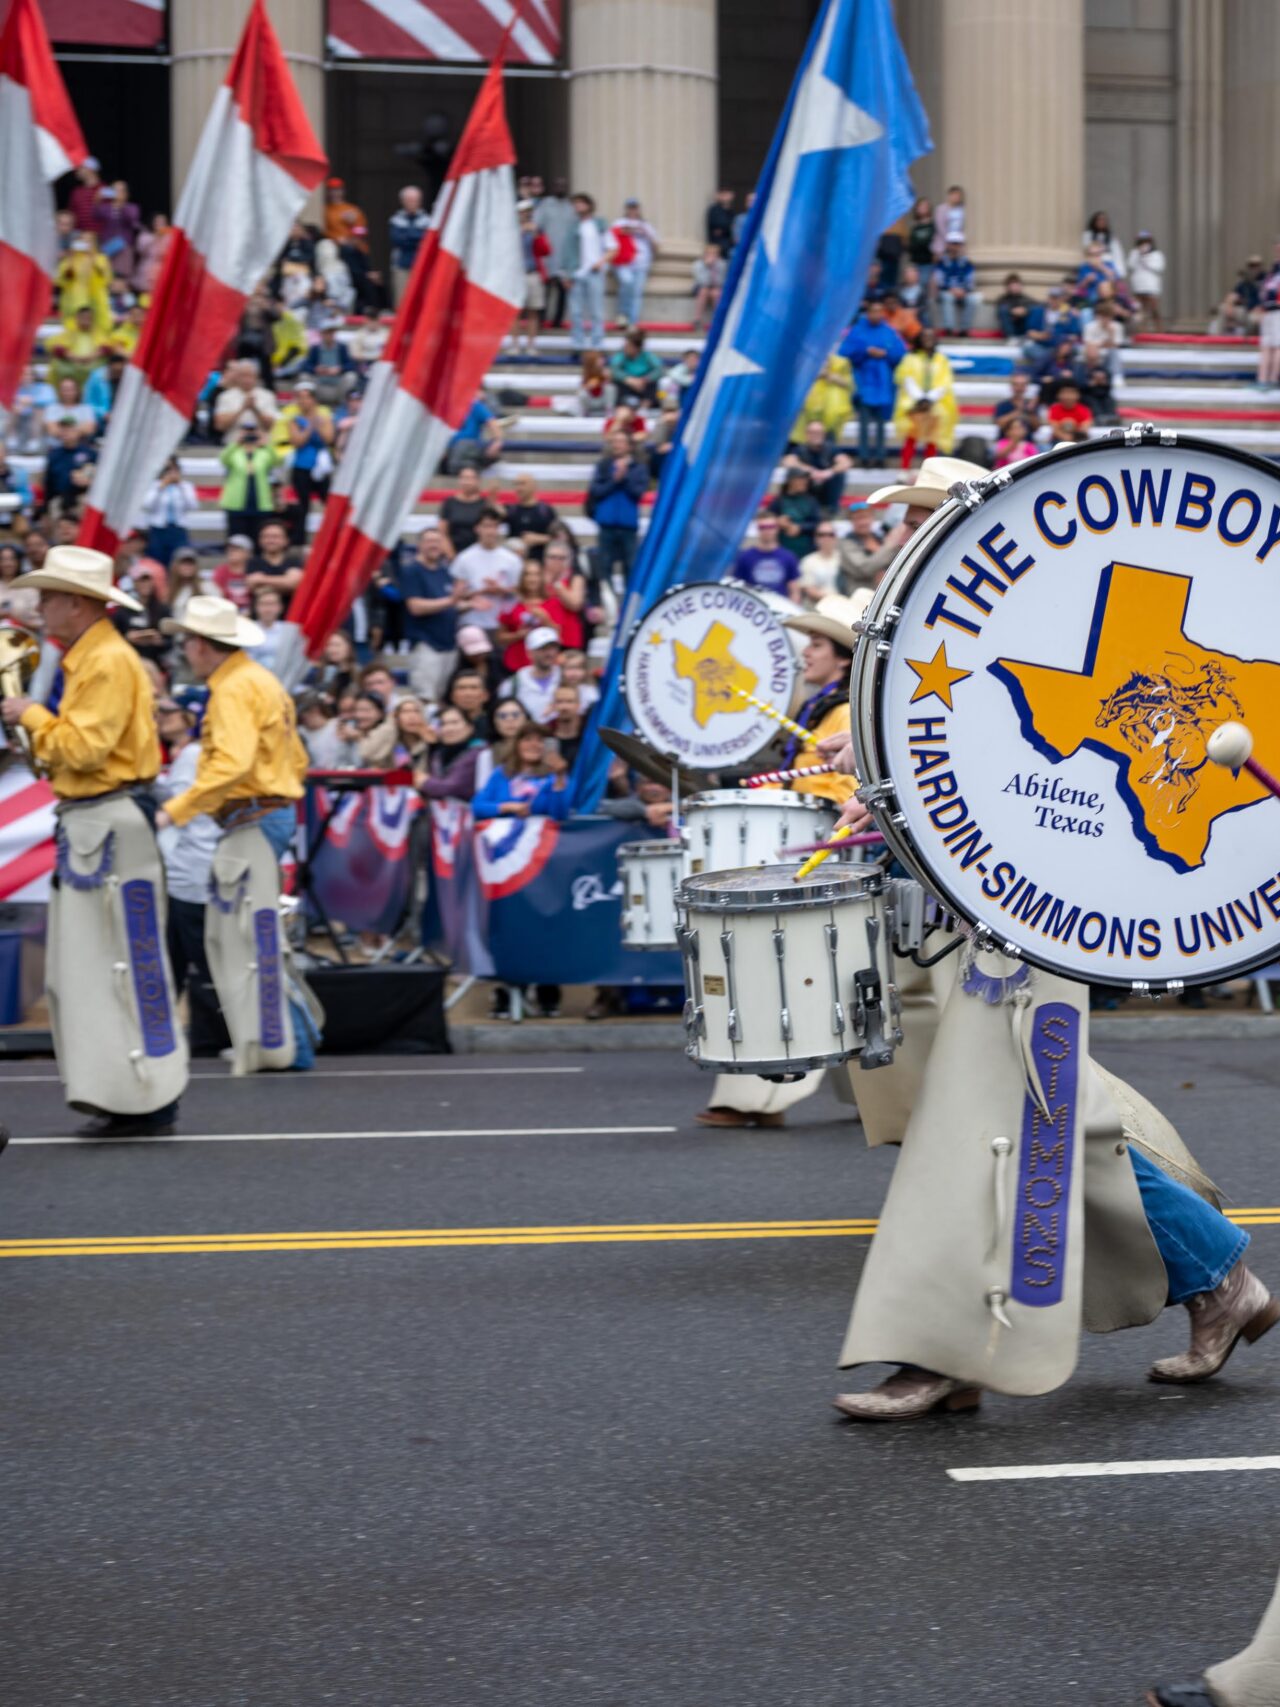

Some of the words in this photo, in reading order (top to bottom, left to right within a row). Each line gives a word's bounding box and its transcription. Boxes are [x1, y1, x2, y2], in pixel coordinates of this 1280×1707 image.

[923, 521, 1036, 637] THE
[661, 595, 697, 627] THE
[701, 590, 780, 636] COWBOY
[767, 638, 788, 695] BAND
[907, 715, 1162, 958] HARDIN-SIMMONS
[1001, 772, 1106, 814] Abilene,
[1034, 804, 1105, 839] Texas
[1022, 1016, 1071, 1288] SIMMONS
